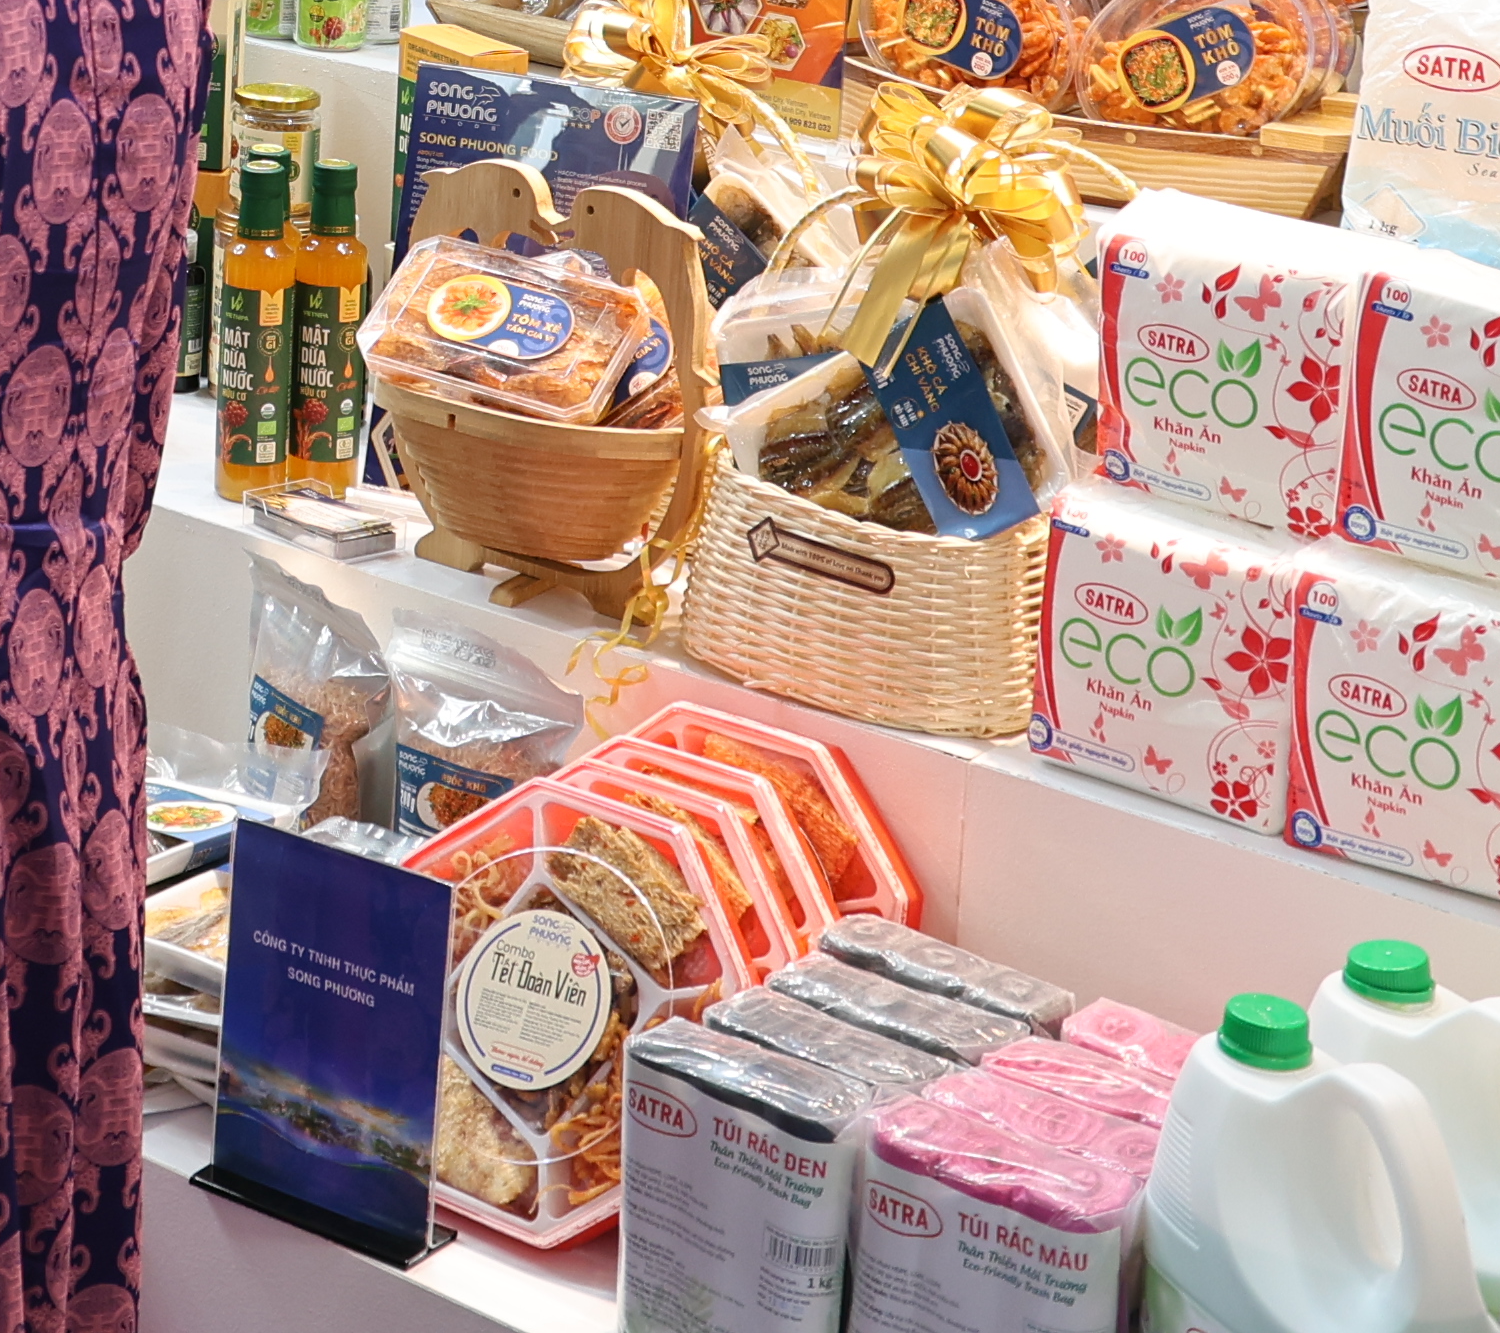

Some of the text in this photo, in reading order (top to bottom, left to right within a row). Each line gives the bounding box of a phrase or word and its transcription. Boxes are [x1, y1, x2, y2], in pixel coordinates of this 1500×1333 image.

[1416, 53, 1487, 86] SATRA
[1357, 99, 1446, 153] Muối
[1467, 161, 1499, 181] Sea
[1148, 330, 1196, 357] SATRA
[1124, 357, 1259, 429] eco
[1154, 416, 1222, 445] Khăn Ăn
[1168, 437, 1206, 456] Napkin
[253, 930, 415, 997] CÔNG TY TNHH THỰC PHẨM
[287, 966, 375, 1008] SONG PHƯƠNG
[628, 1087, 685, 1130] SATRA
[713, 1115, 828, 1180] TÚI RÁC ĐEN
